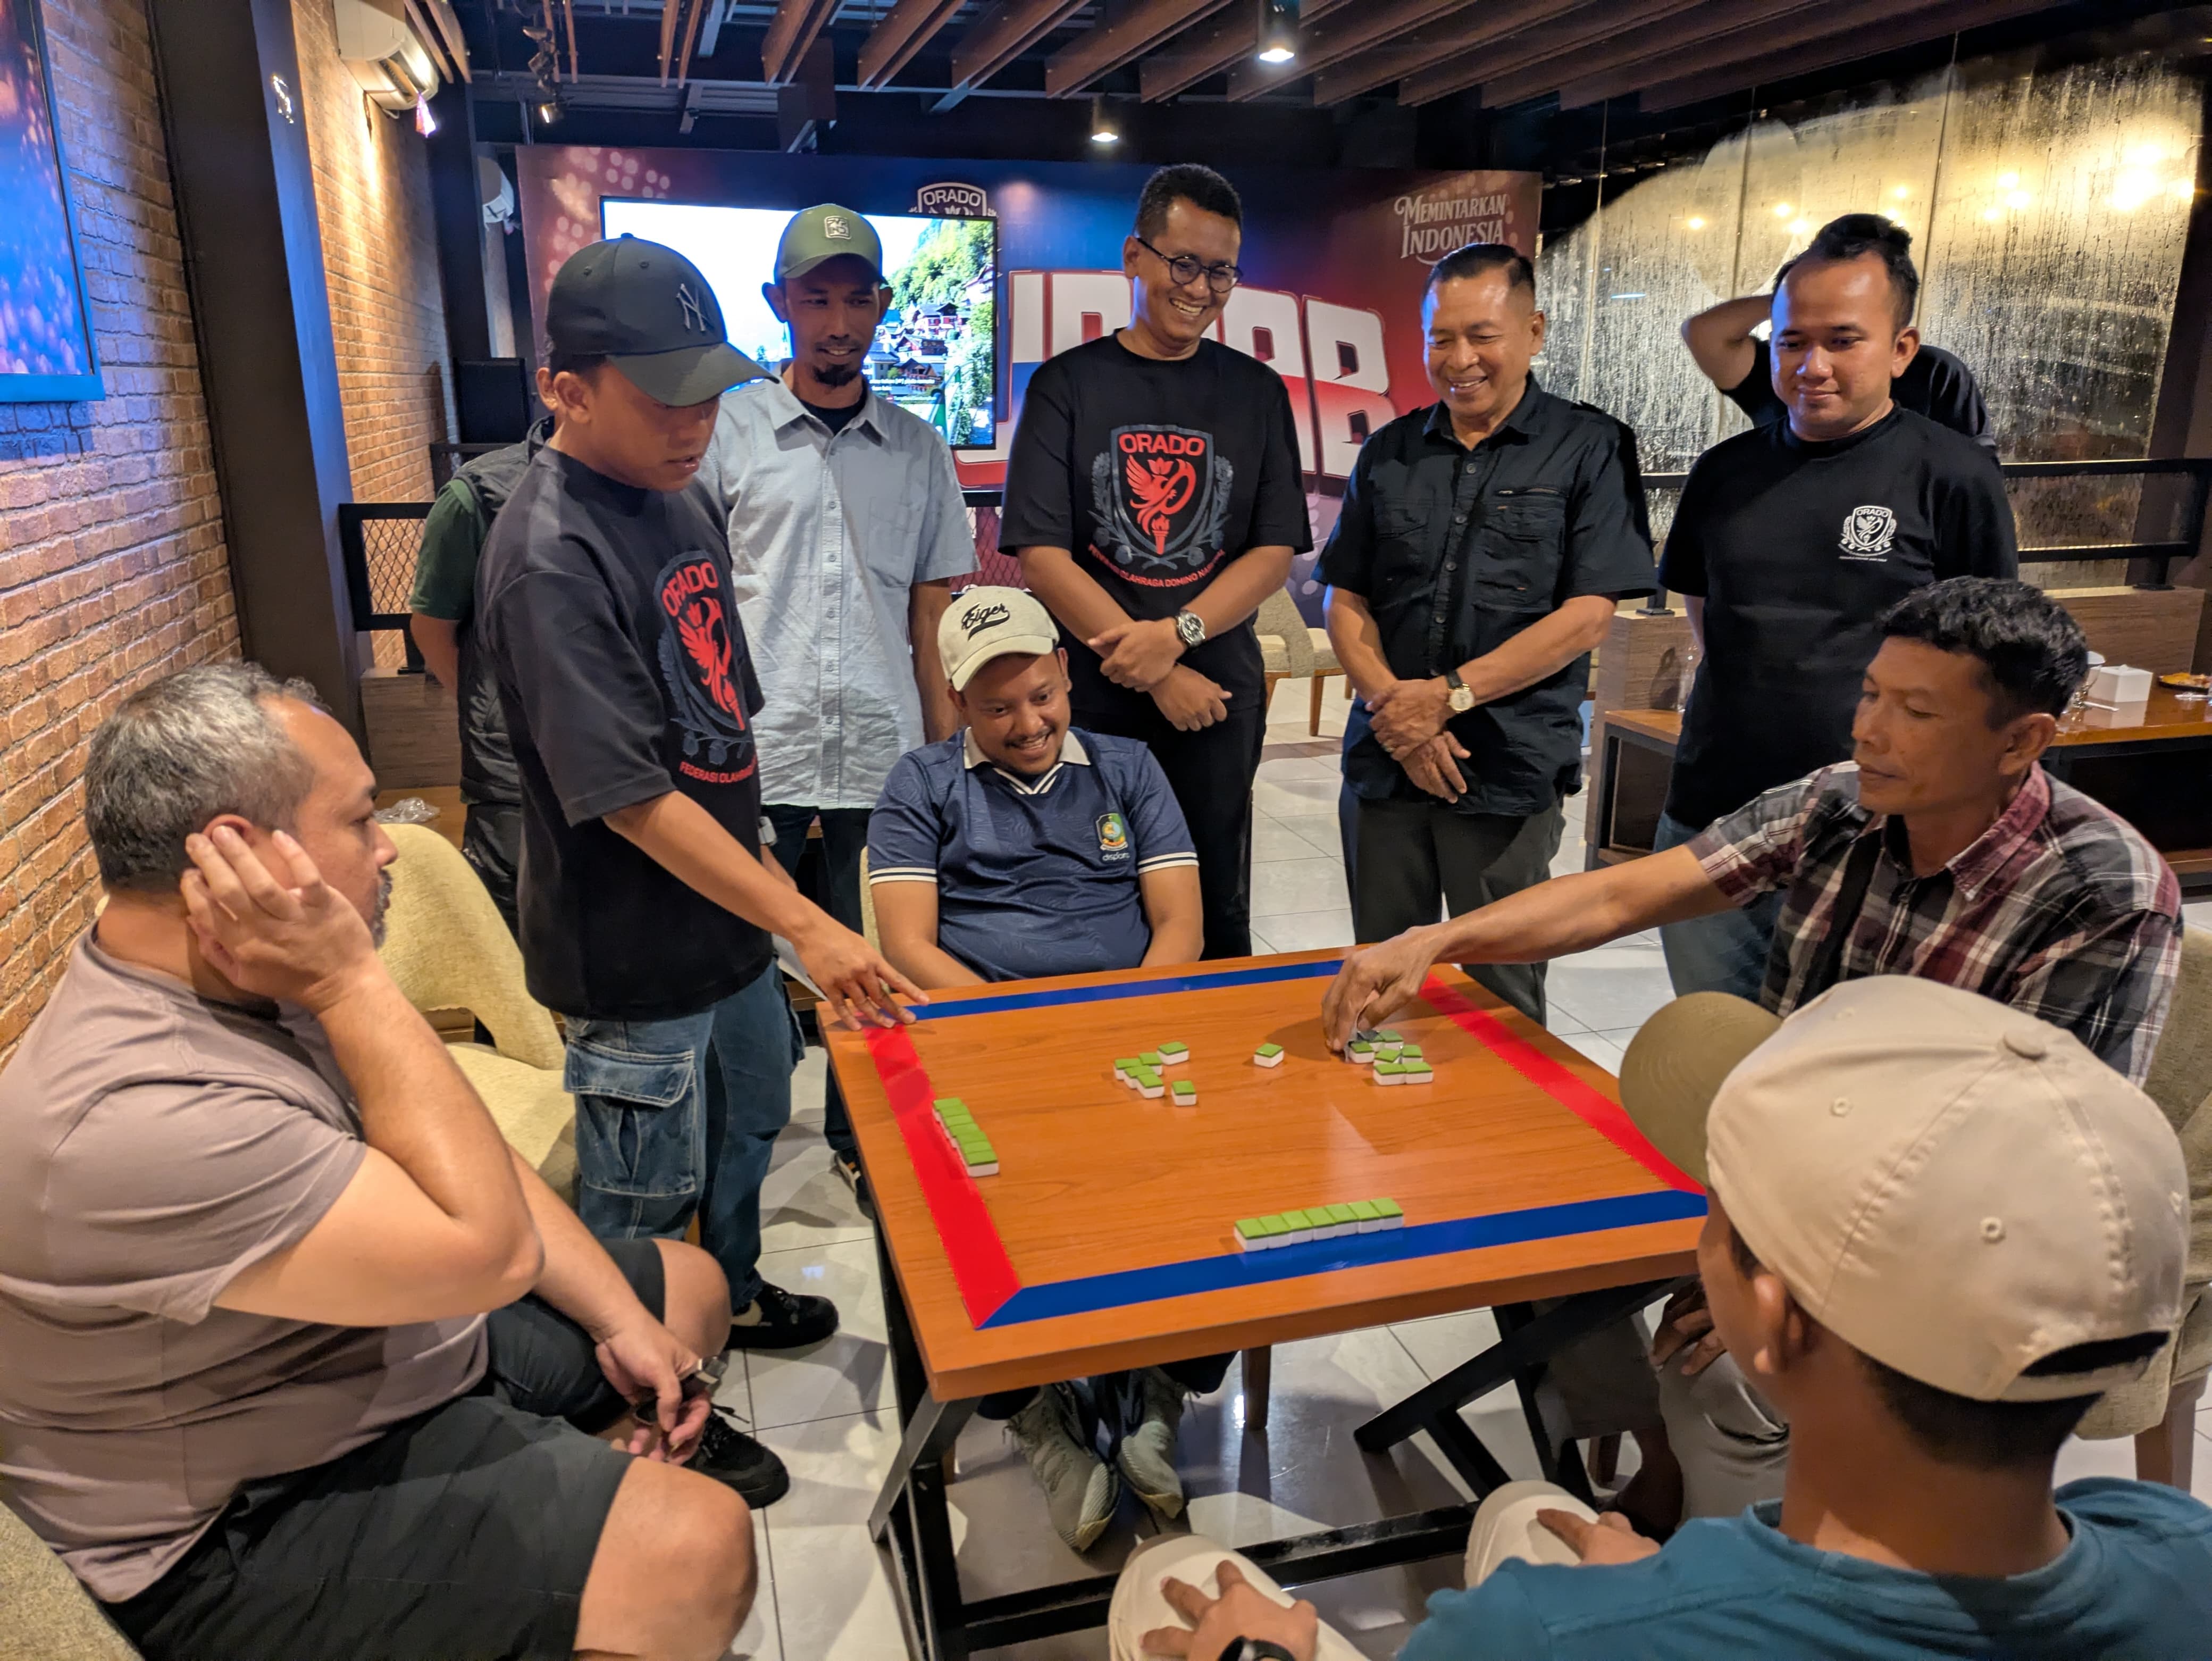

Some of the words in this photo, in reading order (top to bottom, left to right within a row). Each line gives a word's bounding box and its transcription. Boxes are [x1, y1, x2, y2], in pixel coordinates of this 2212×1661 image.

[923, 188, 982, 207] ORADO
[1400, 219, 1504, 259] INDONESIA
[1118, 433, 1206, 457] ORADO
[1856, 508, 1889, 518] ORADO
[661, 562, 719, 617] ORADO
